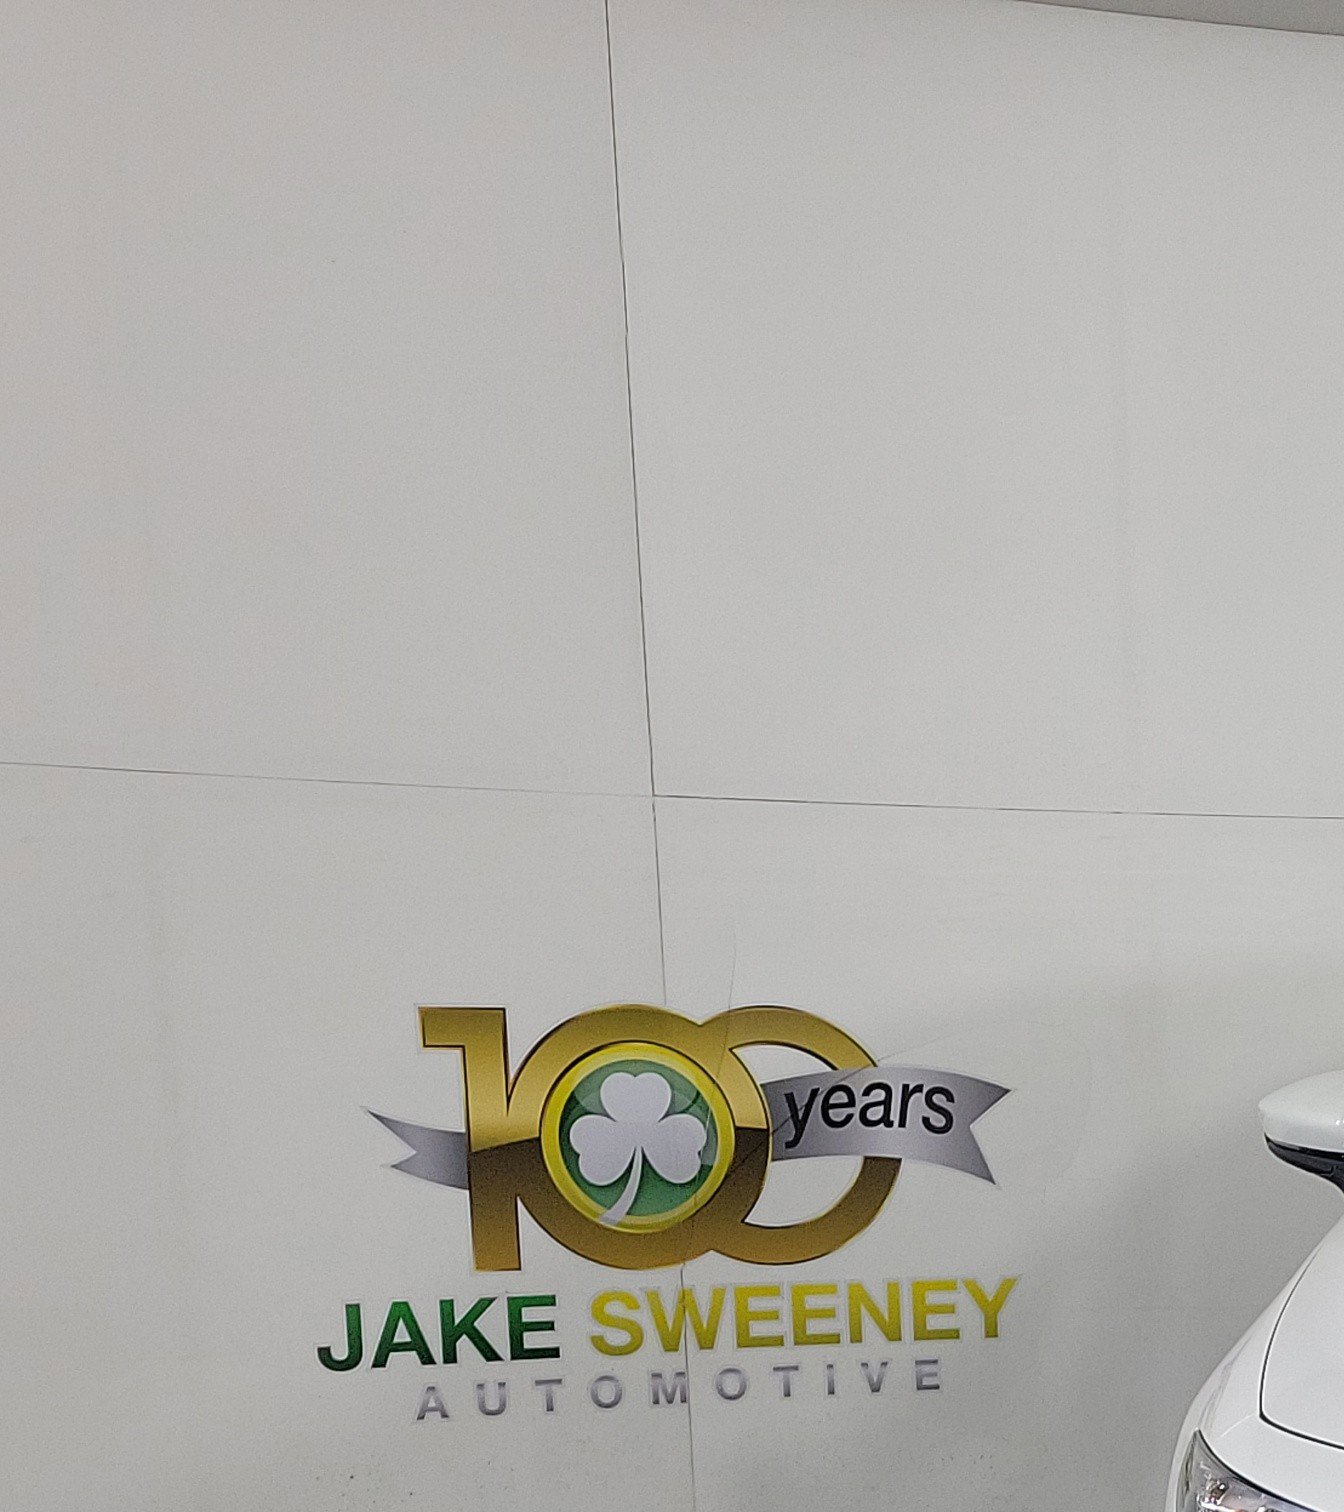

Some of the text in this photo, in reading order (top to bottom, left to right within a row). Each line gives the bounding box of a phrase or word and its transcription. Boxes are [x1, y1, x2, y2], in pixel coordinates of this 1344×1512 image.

[418, 1004, 955, 1270] 100 years
[317, 1277, 1019, 1372] JAKE SWEENEY
[416, 1359, 941, 1421] AUTOMOTIVE
